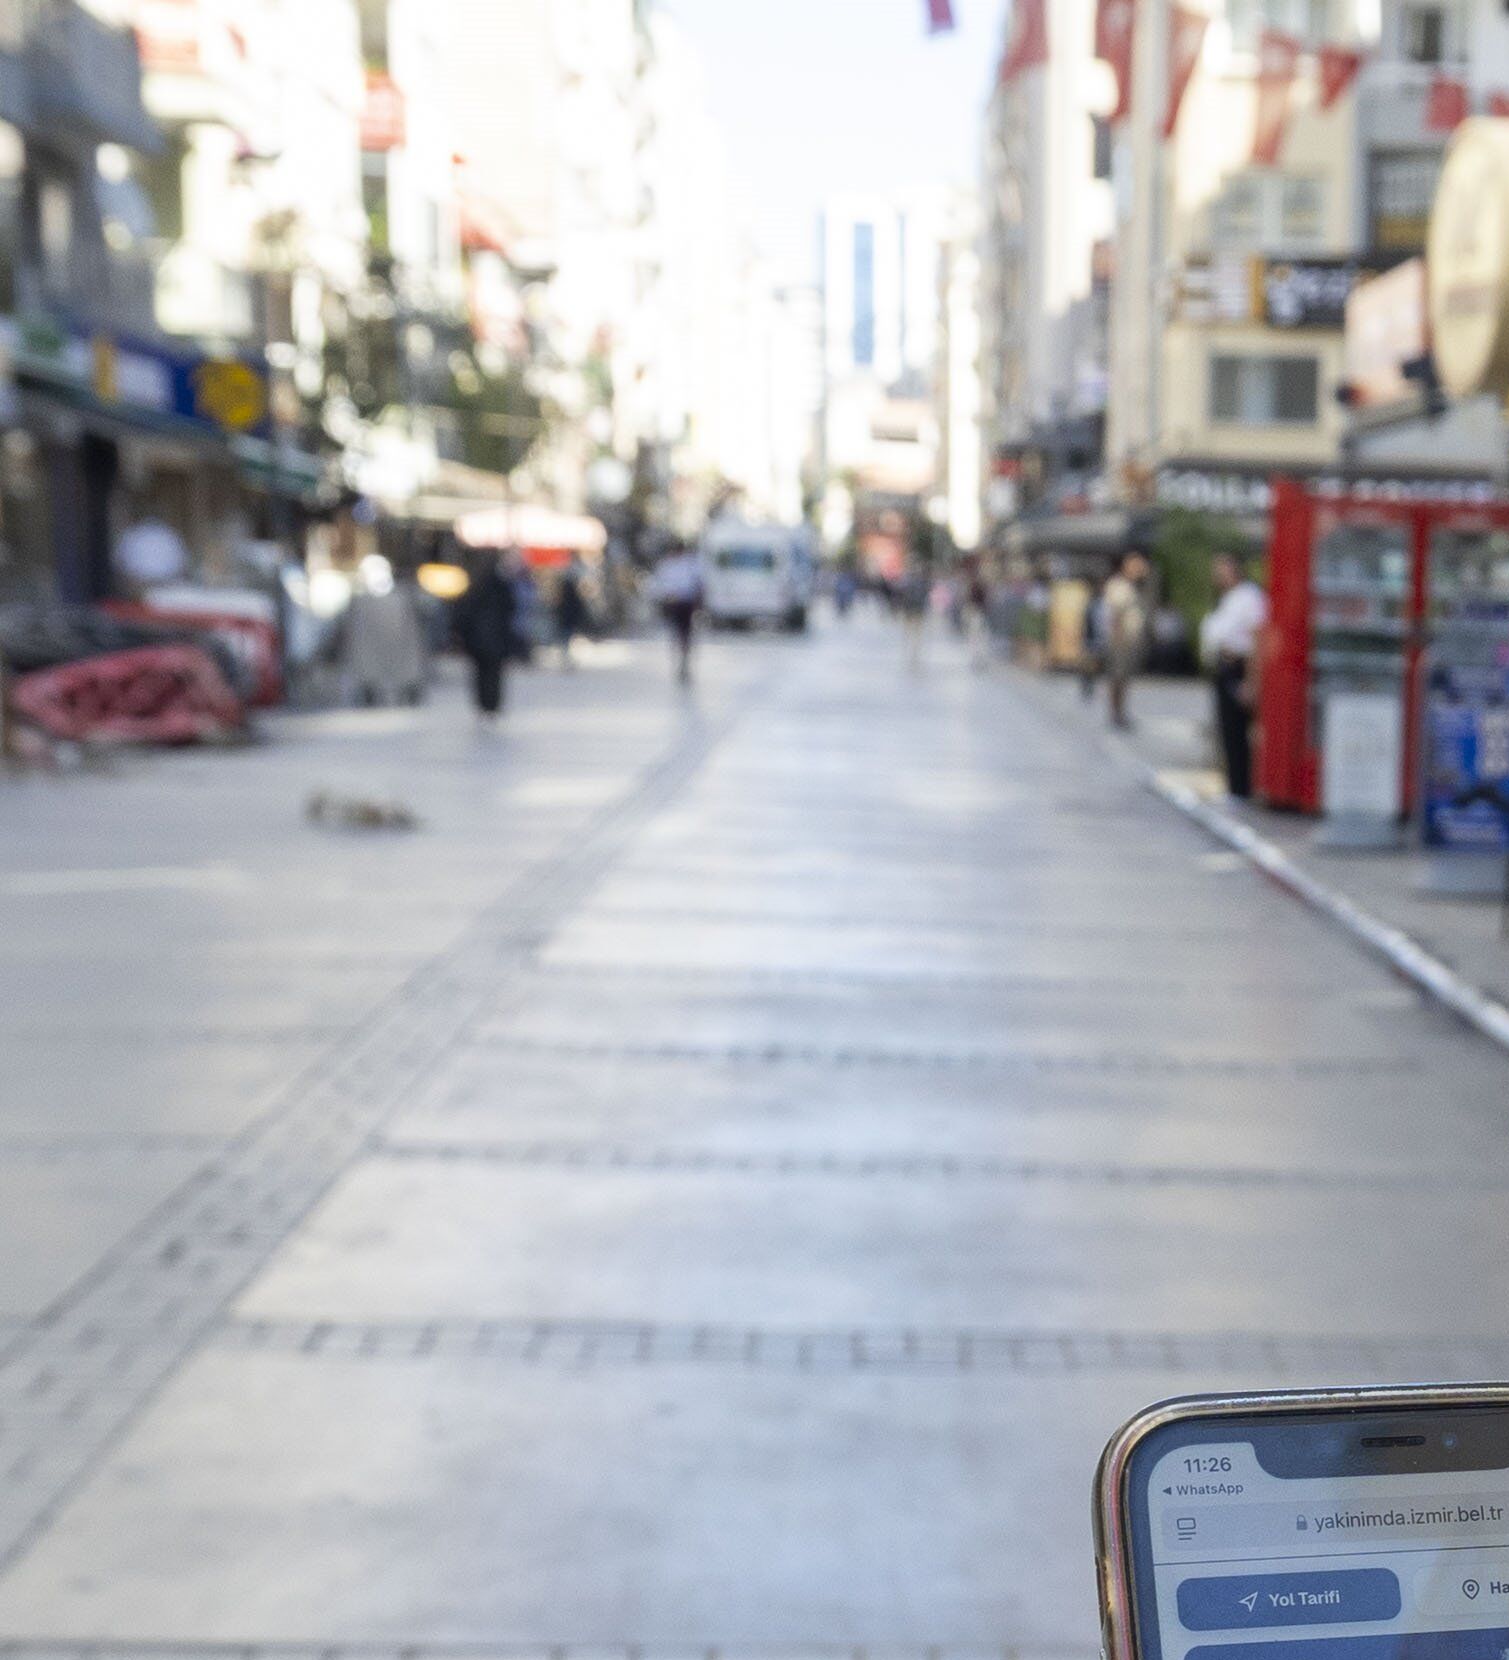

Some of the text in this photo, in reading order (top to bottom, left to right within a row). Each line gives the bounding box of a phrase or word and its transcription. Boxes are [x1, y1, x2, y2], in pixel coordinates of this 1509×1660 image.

[1184, 1456, 1233, 1474] 11:26
[1176, 1482, 1245, 1499] WhatsApp
[1314, 1505, 1505, 1533] yakinimda.izmir.bel.tr
[1268, 1589, 1341, 1607] Yol Tarifi
